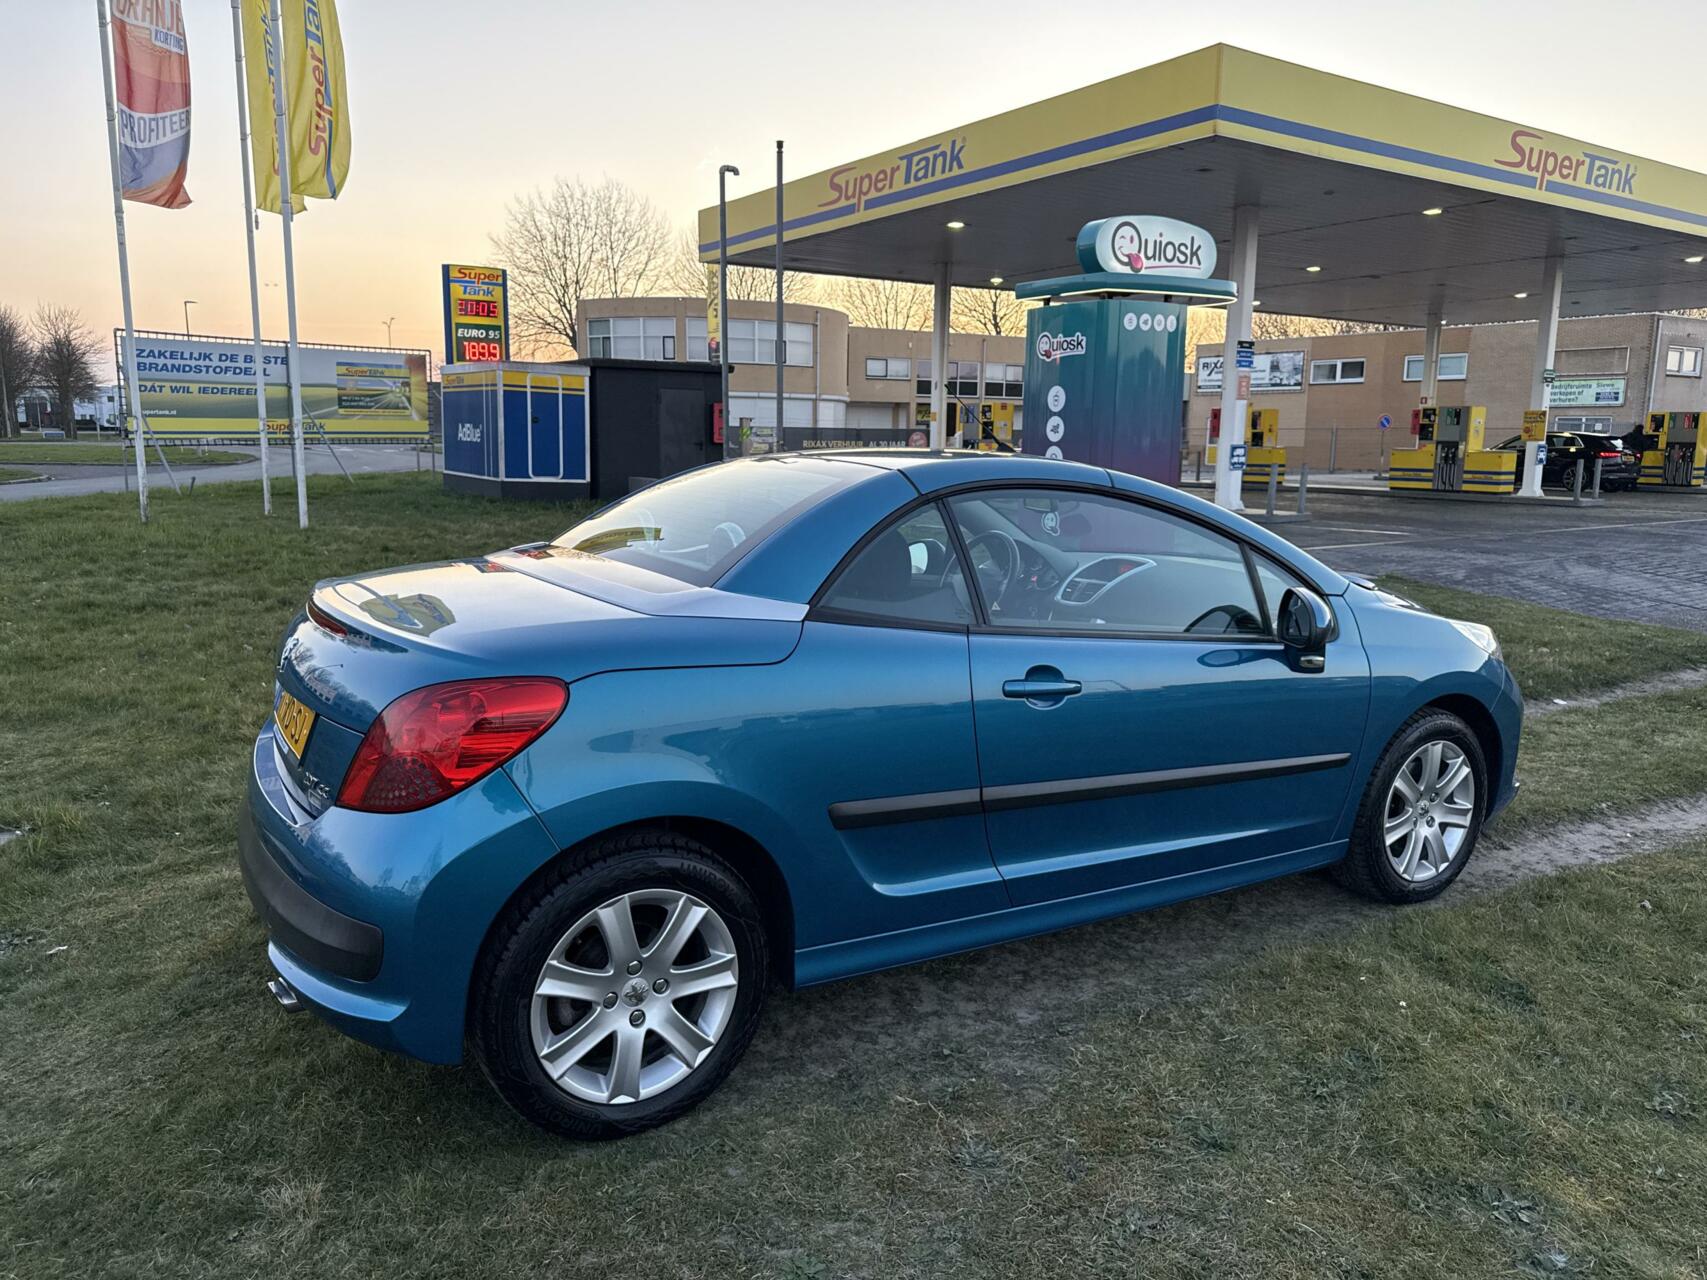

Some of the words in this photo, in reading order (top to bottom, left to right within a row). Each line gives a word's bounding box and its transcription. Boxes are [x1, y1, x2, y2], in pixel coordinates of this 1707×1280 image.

[154, 28, 184, 51] KORTING
[303, 0, 335, 178] SuperTa
[119, 107, 191, 144] PROFITEER
[1494, 129, 1637, 195] SuperTank
[818, 139, 966, 213] SuperTank
[1111, 220, 1202, 274] Quiosk
[452, 267, 501, 285] Super
[459, 284, 495, 298] Tank
[457, 328, 486, 339] EURO
[487, 329, 501, 340] 95
[136, 348, 214, 362] ZAKELIJK
[218, 352, 239, 364] DE
[243, 354, 288, 366] BSTE
[1037, 333, 1085, 360] Quiosk
[139, 382, 166, 394] DÁT
[170, 385, 193, 394] WIL
[458, 423, 482, 443] AdBlue
